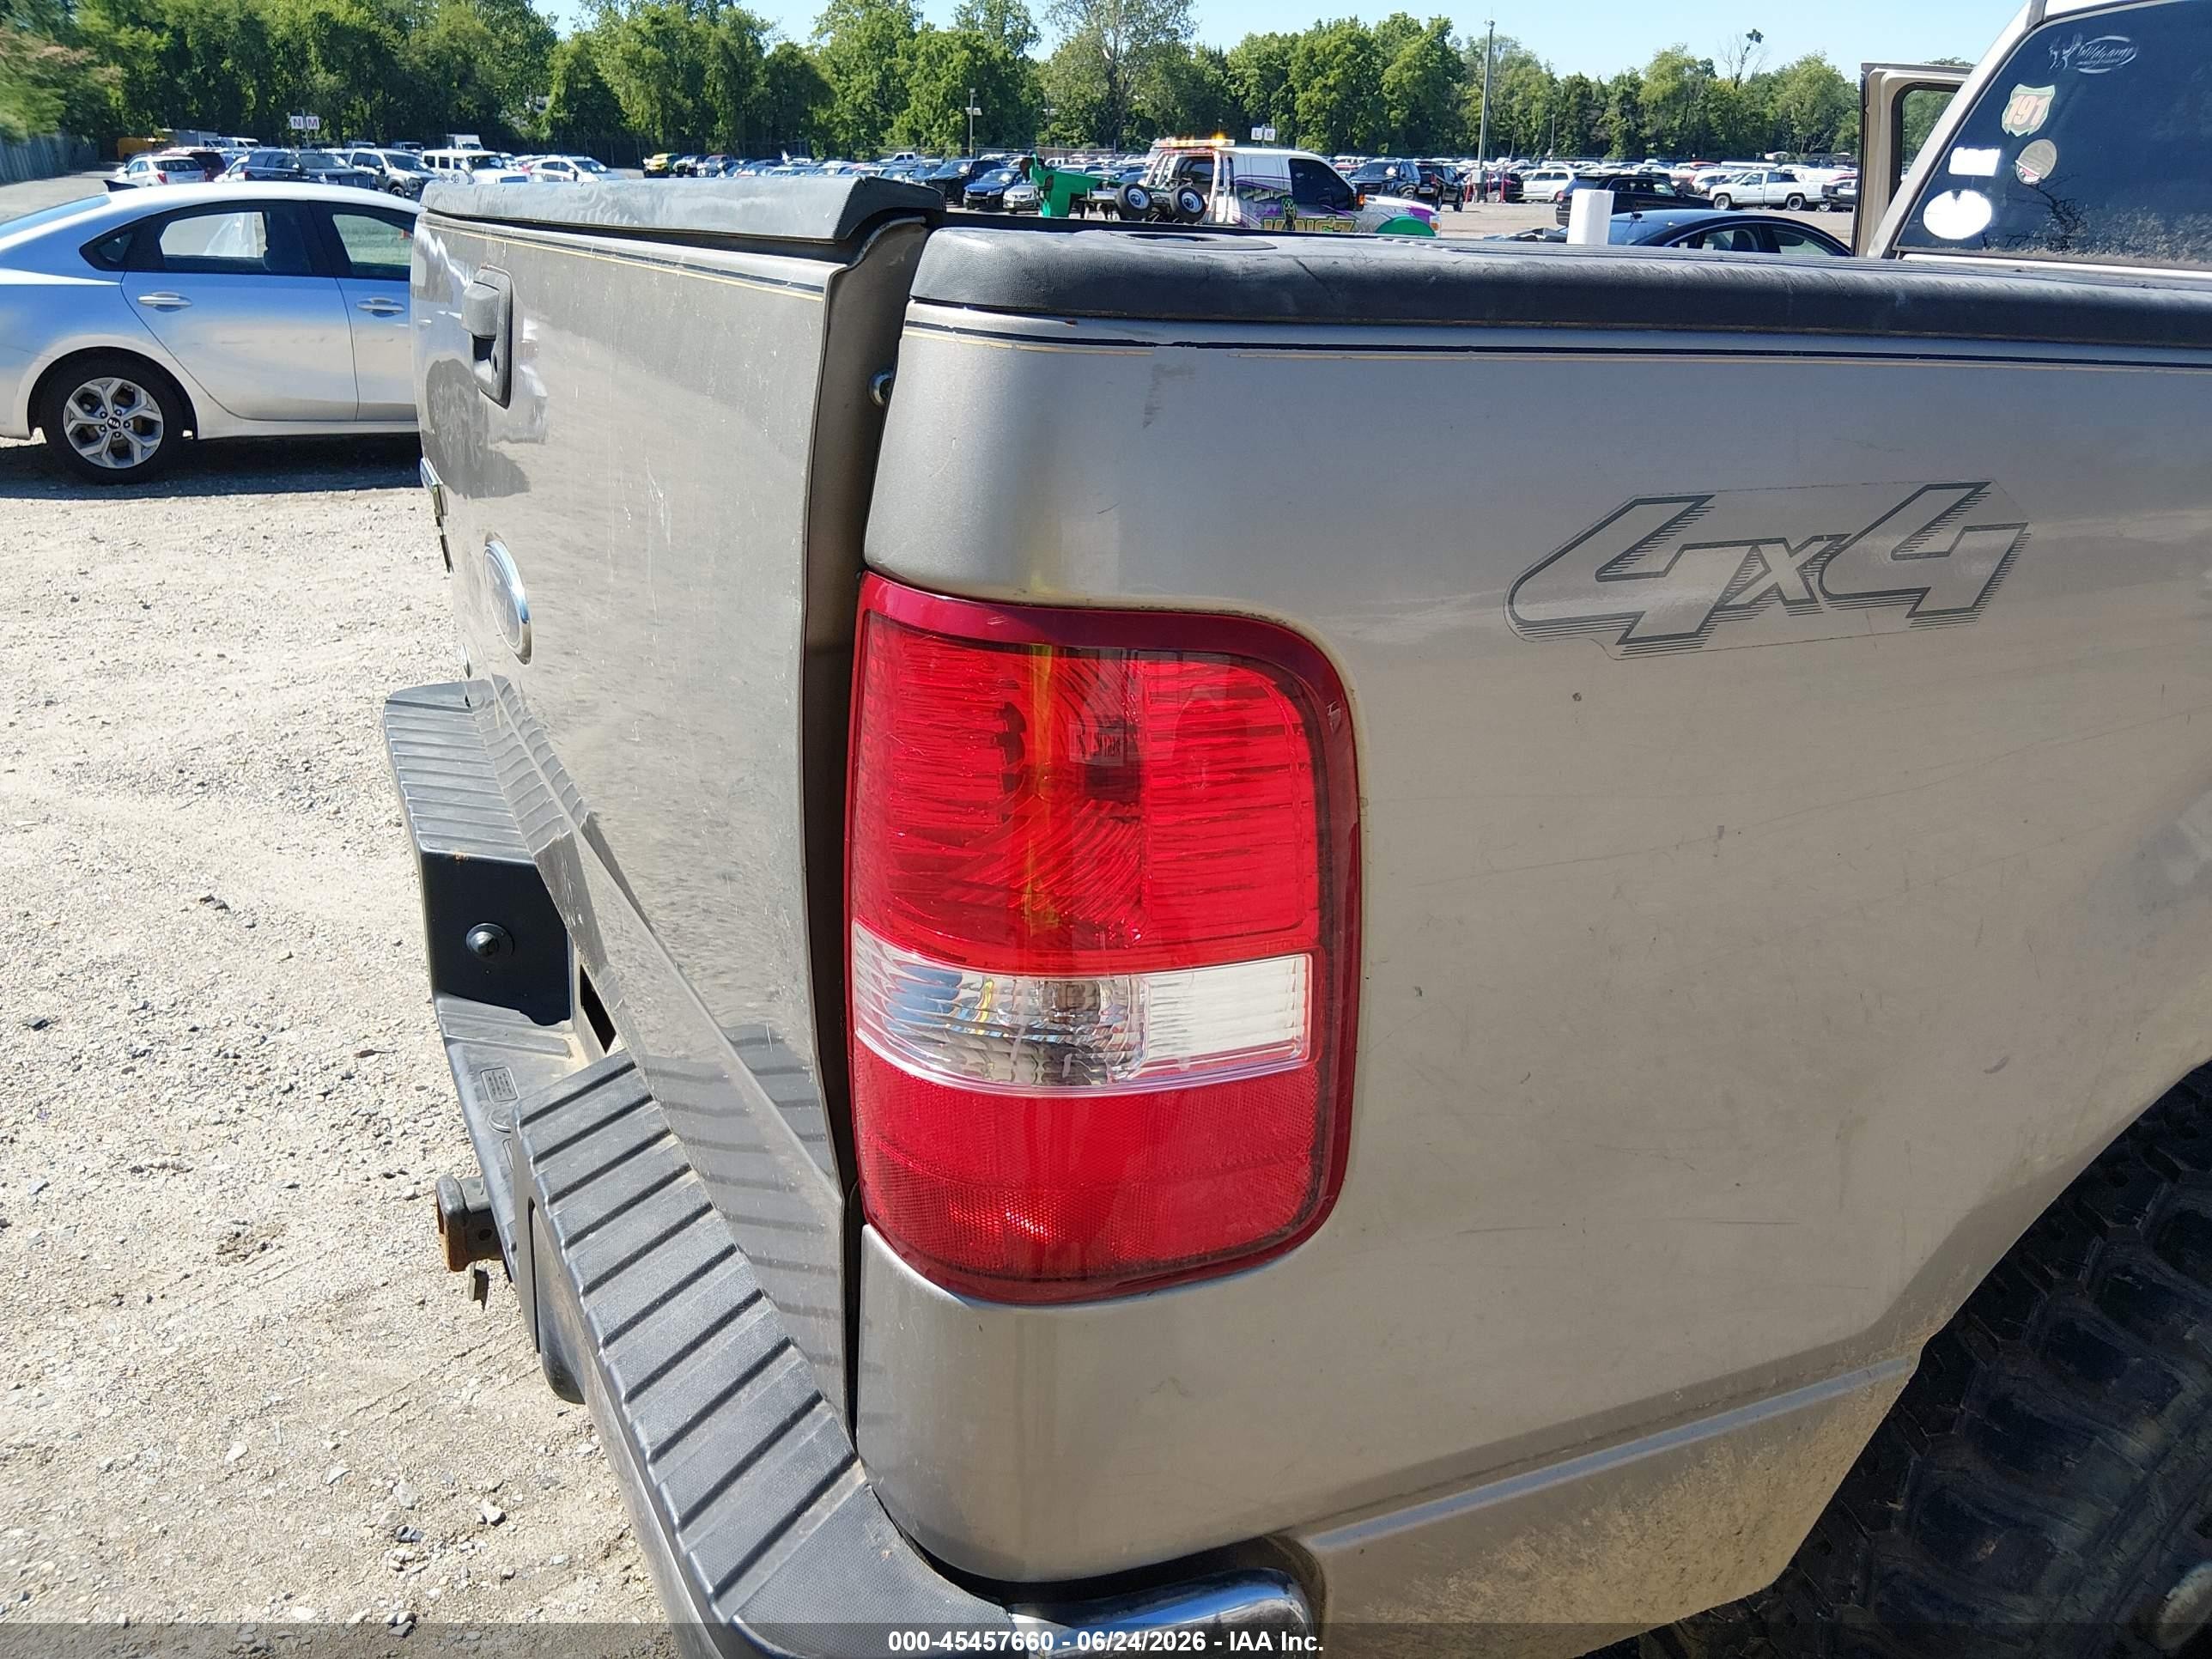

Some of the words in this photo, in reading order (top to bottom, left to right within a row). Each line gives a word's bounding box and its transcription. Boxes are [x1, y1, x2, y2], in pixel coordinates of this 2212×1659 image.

[2004, 94, 2050, 126] 191
[293, 118, 301, 127] N
[308, 118, 319, 128] M
